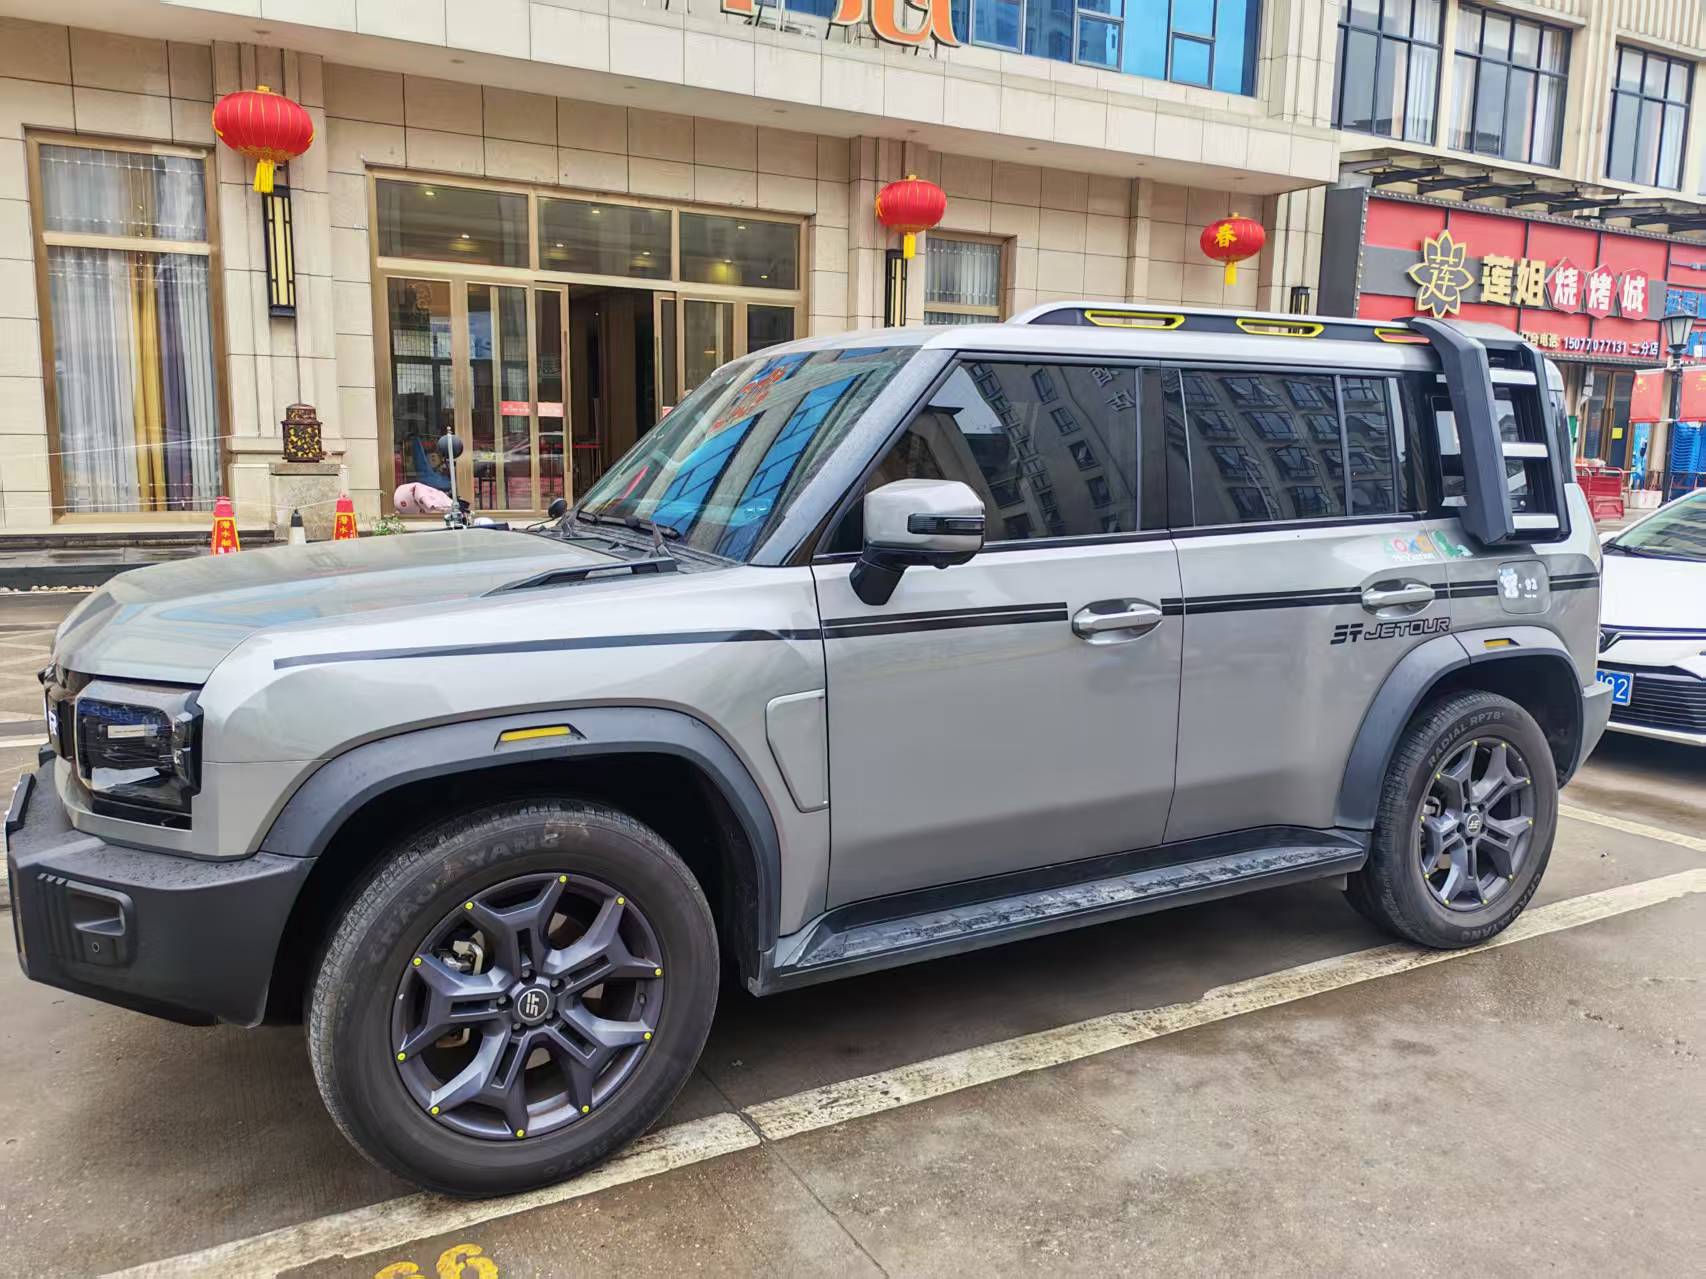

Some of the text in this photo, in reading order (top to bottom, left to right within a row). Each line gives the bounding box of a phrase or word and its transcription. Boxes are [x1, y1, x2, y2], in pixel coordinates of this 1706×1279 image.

[1216, 223, 1237, 248] 春
[1480, 253, 1646, 312] 莲姐烧烤城
[1564, 337, 1627, 354] 15077077131
[1631, 342, 1659, 356] 二分店
[1364, 617, 1451, 640] JETOUR
[1428, 722, 1468, 767] RADIAL
